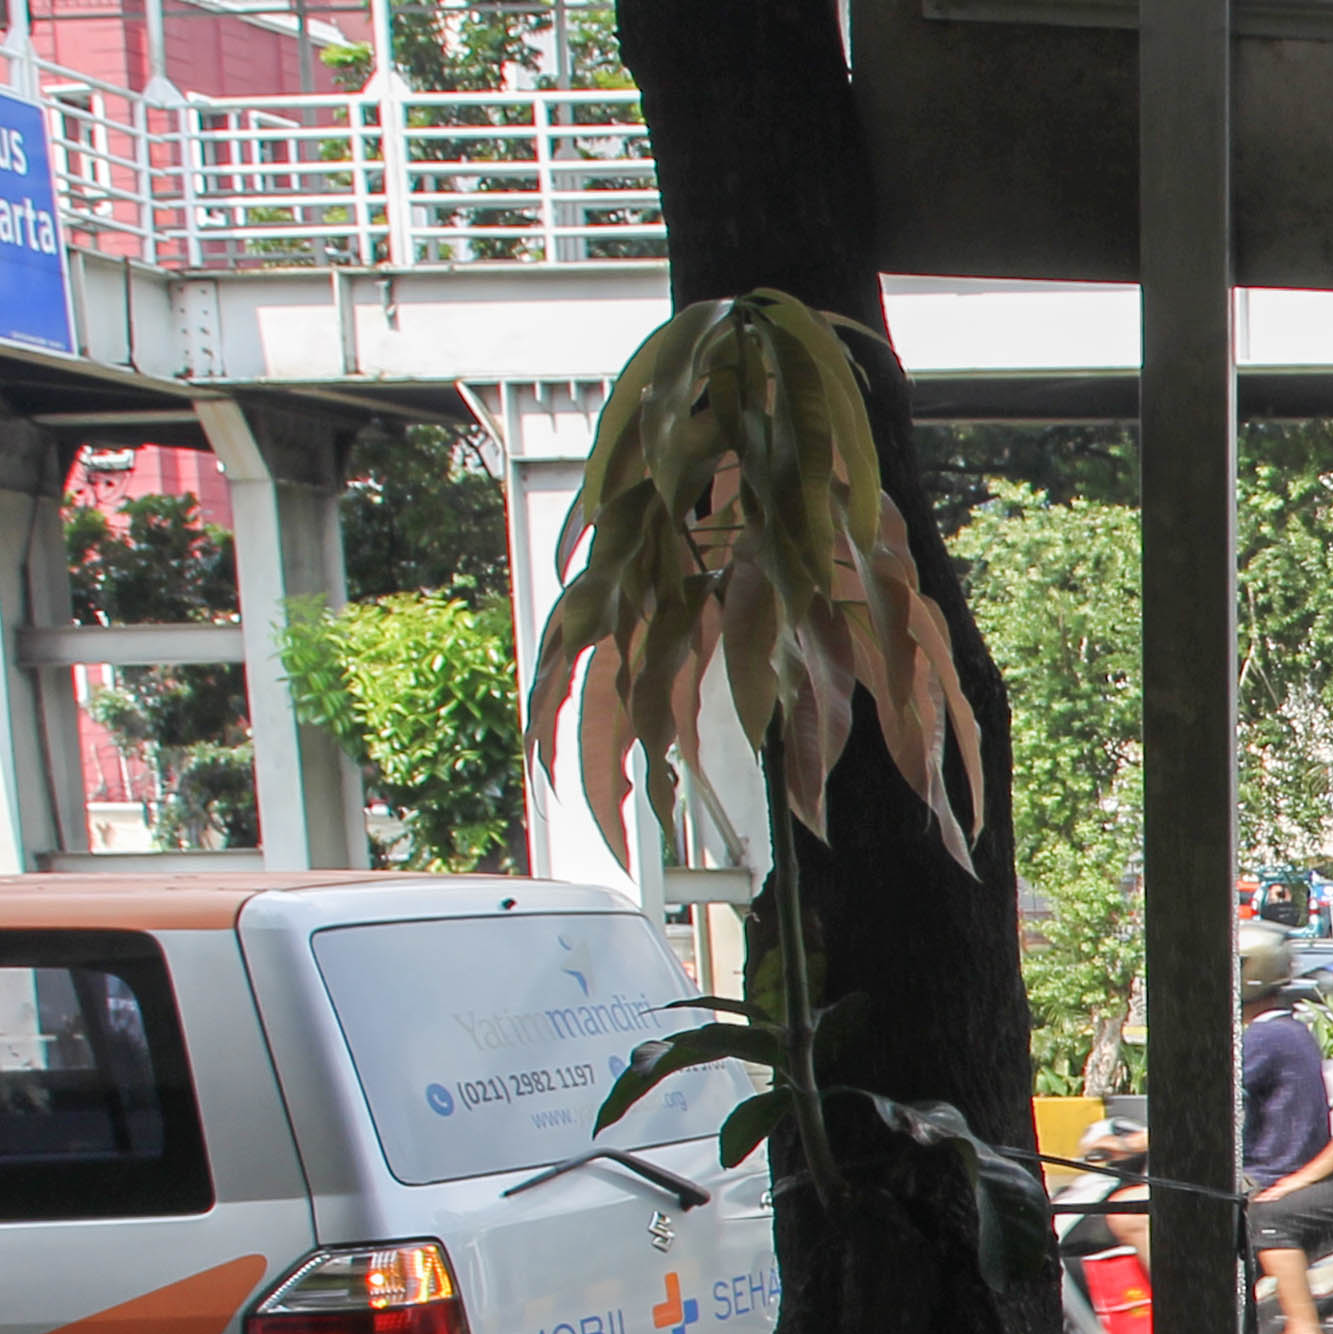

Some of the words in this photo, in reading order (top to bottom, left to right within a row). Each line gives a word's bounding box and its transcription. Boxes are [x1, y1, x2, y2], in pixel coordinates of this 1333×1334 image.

[457, 1075, 511, 1111] (021)
[509, 1069, 557, 1096] 2982
[556, 1063, 595, 1089] 1197
